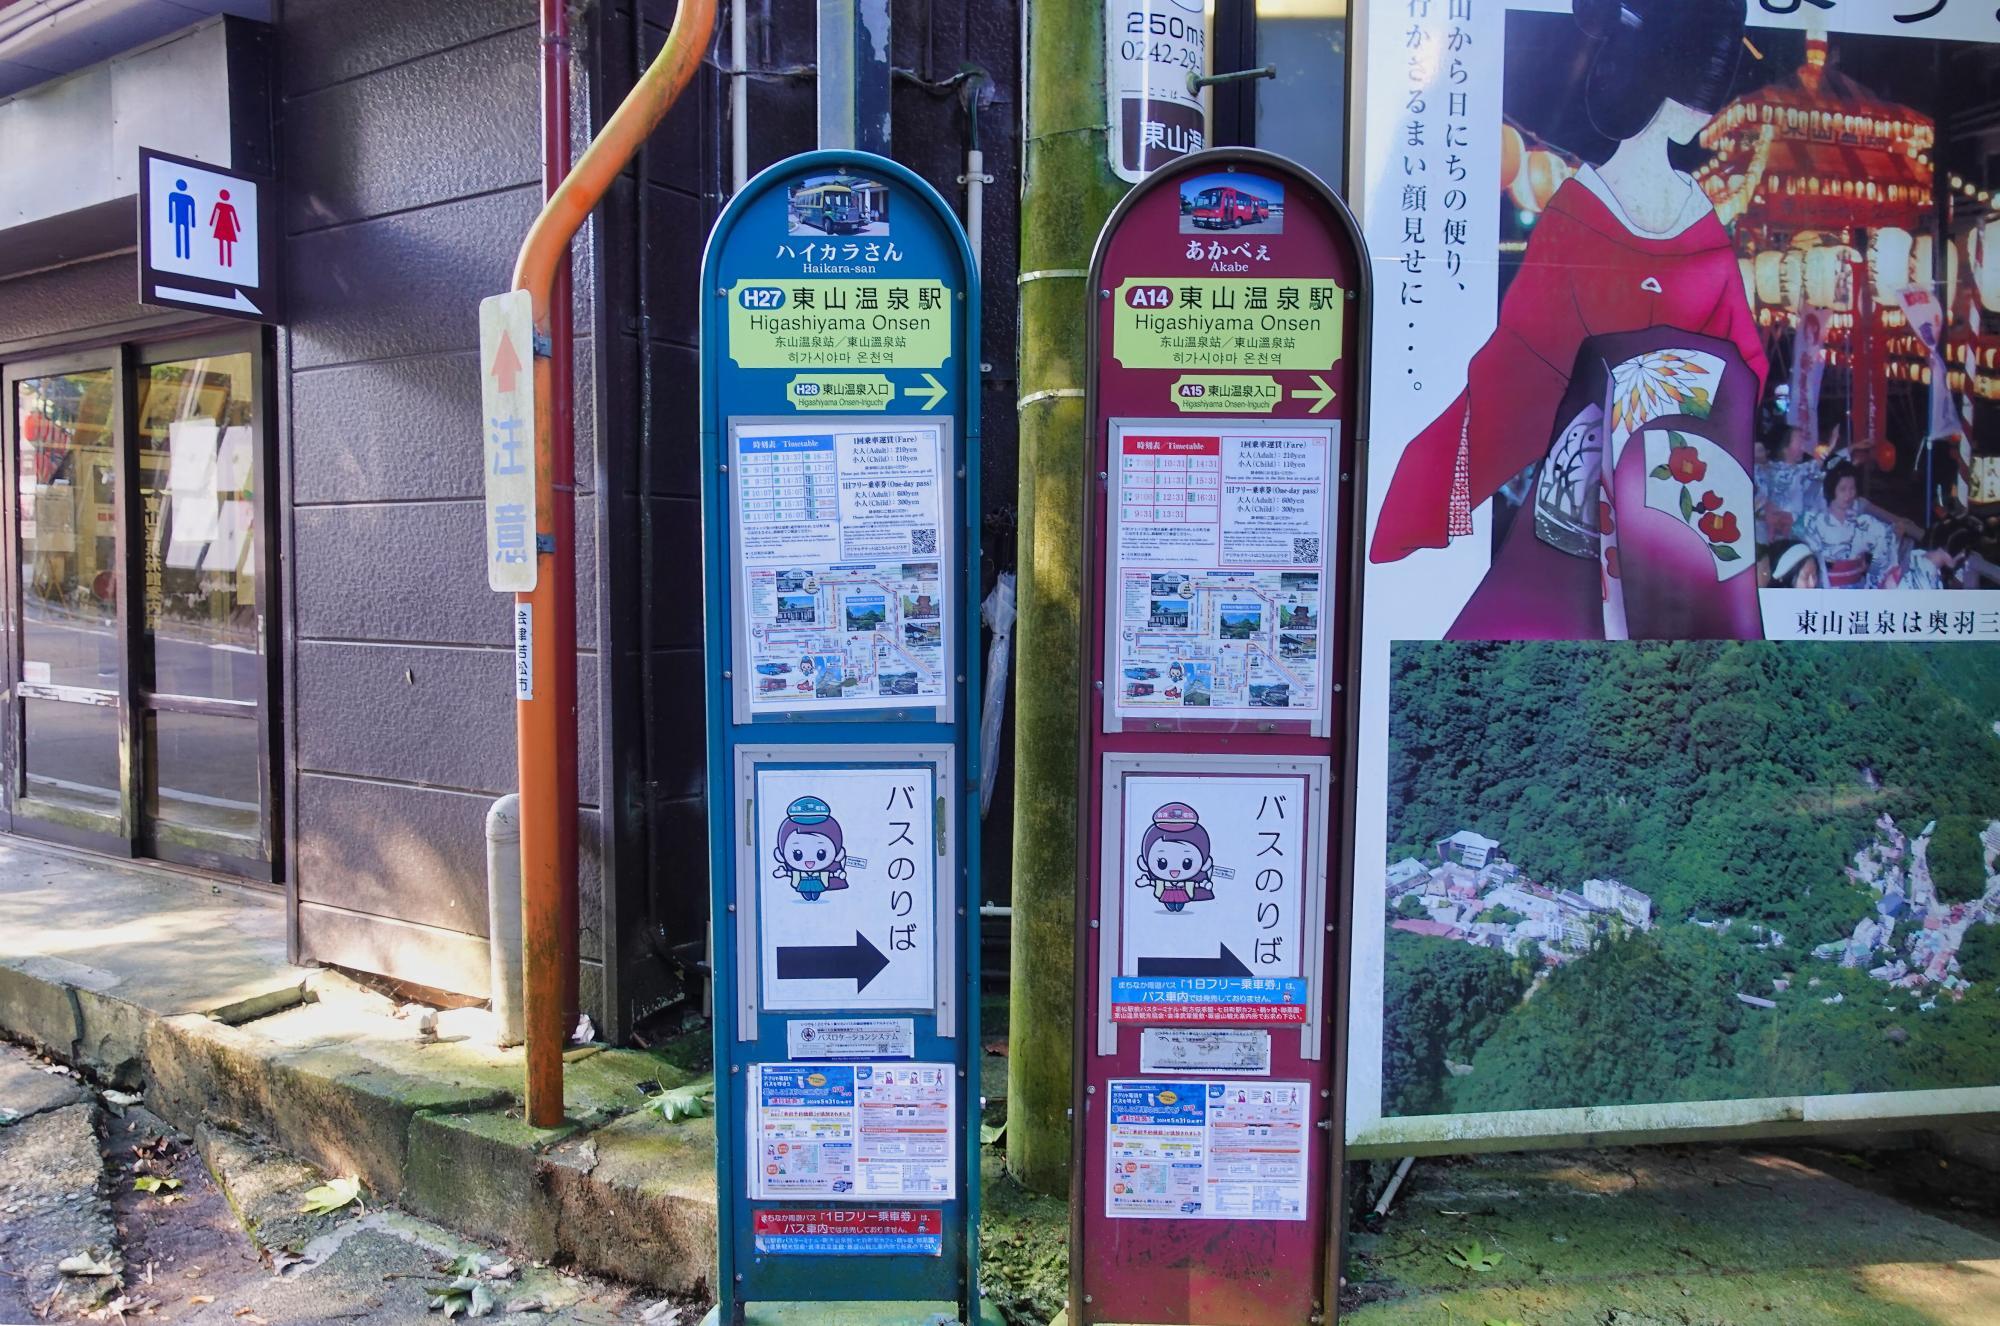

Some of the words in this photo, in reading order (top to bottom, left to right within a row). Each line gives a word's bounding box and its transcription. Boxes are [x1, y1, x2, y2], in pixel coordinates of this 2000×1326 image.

[1127, 12, 1205, 50] 250m
[1141, 121, 1205, 154] 東山温
[776, 242, 903, 262] ハイカラさん
[1186, 240, 1271, 261] あかべぇ
[802, 263, 876, 273] Haikara-san
[1210, 261, 1249, 272] Akabe
[744, 291, 782, 307] H27
[792, 286, 942, 311] 東山温泉駅
[1131, 288, 1169, 306] A14
[1179, 286, 1334, 311] 東山温泉駅
[750, 314, 866, 334] Higashiyama
[872, 314, 930, 331] Onsen
[1135, 314, 1253, 334] Higashiyama
[1261, 314, 1321, 331] Onsen
[788, 352, 851, 364] 히가시야마
[856, 352, 894, 364] 온천역
[1173, 352, 1238, 365] 히가시야마
[1243, 352, 1282, 365] 온천역
[796, 384, 818, 395] H28
[822, 383, 889, 396] 東山温泉入口
[1181, 385, 1203, 396] A15
[1208, 384, 1276, 397] 東山温泉入口
[1796, 609, 2000, 635] 東山温泉は奥羽三
[886, 785, 917, 951] バスのりば
[1255, 795, 1287, 965] バスのりば
